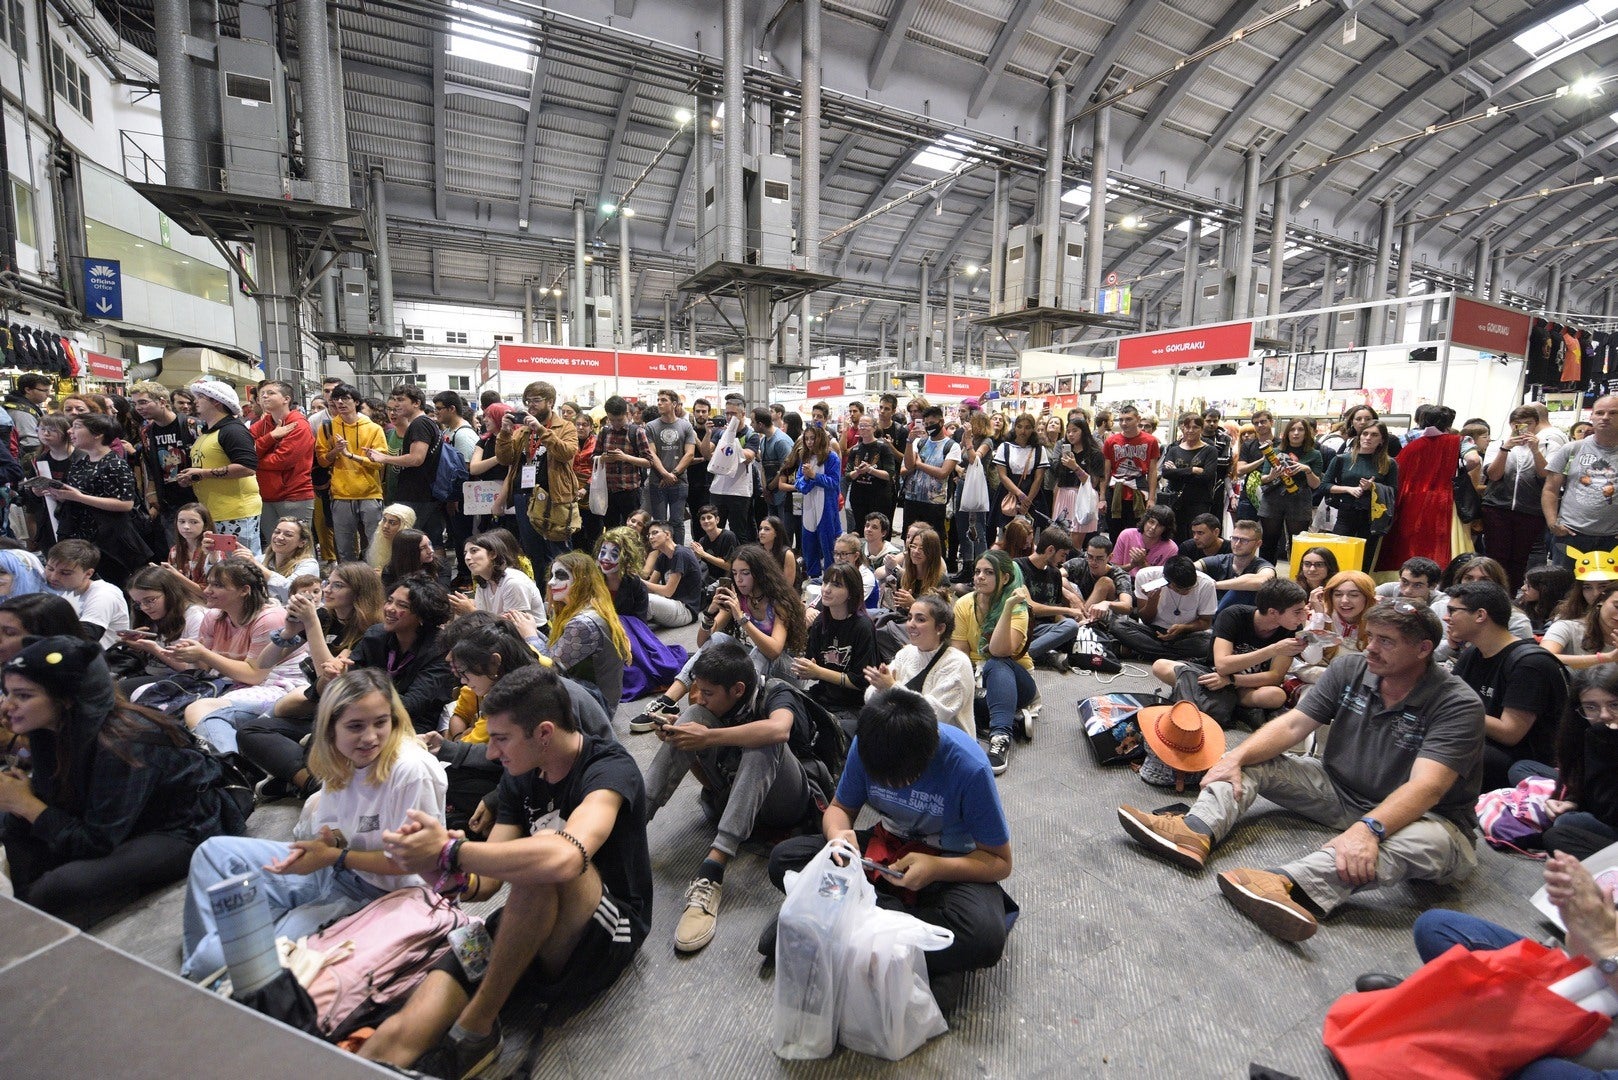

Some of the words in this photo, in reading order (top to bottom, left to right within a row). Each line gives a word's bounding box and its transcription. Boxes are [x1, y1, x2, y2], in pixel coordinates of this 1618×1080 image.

[90, 277, 116, 286] Oficina
[1165, 340, 1206, 353] GOKURAKU
[530, 356, 570, 366] YOROKONDE
[571, 358, 600, 367] STATION
[658, 363, 667, 371] EL
[667, 364, 688, 372] FILTRO
[155, 433, 177, 445] YURI
[1072, 640, 1107, 657] AIRS.
[910, 789, 945, 807] ETERNAL
